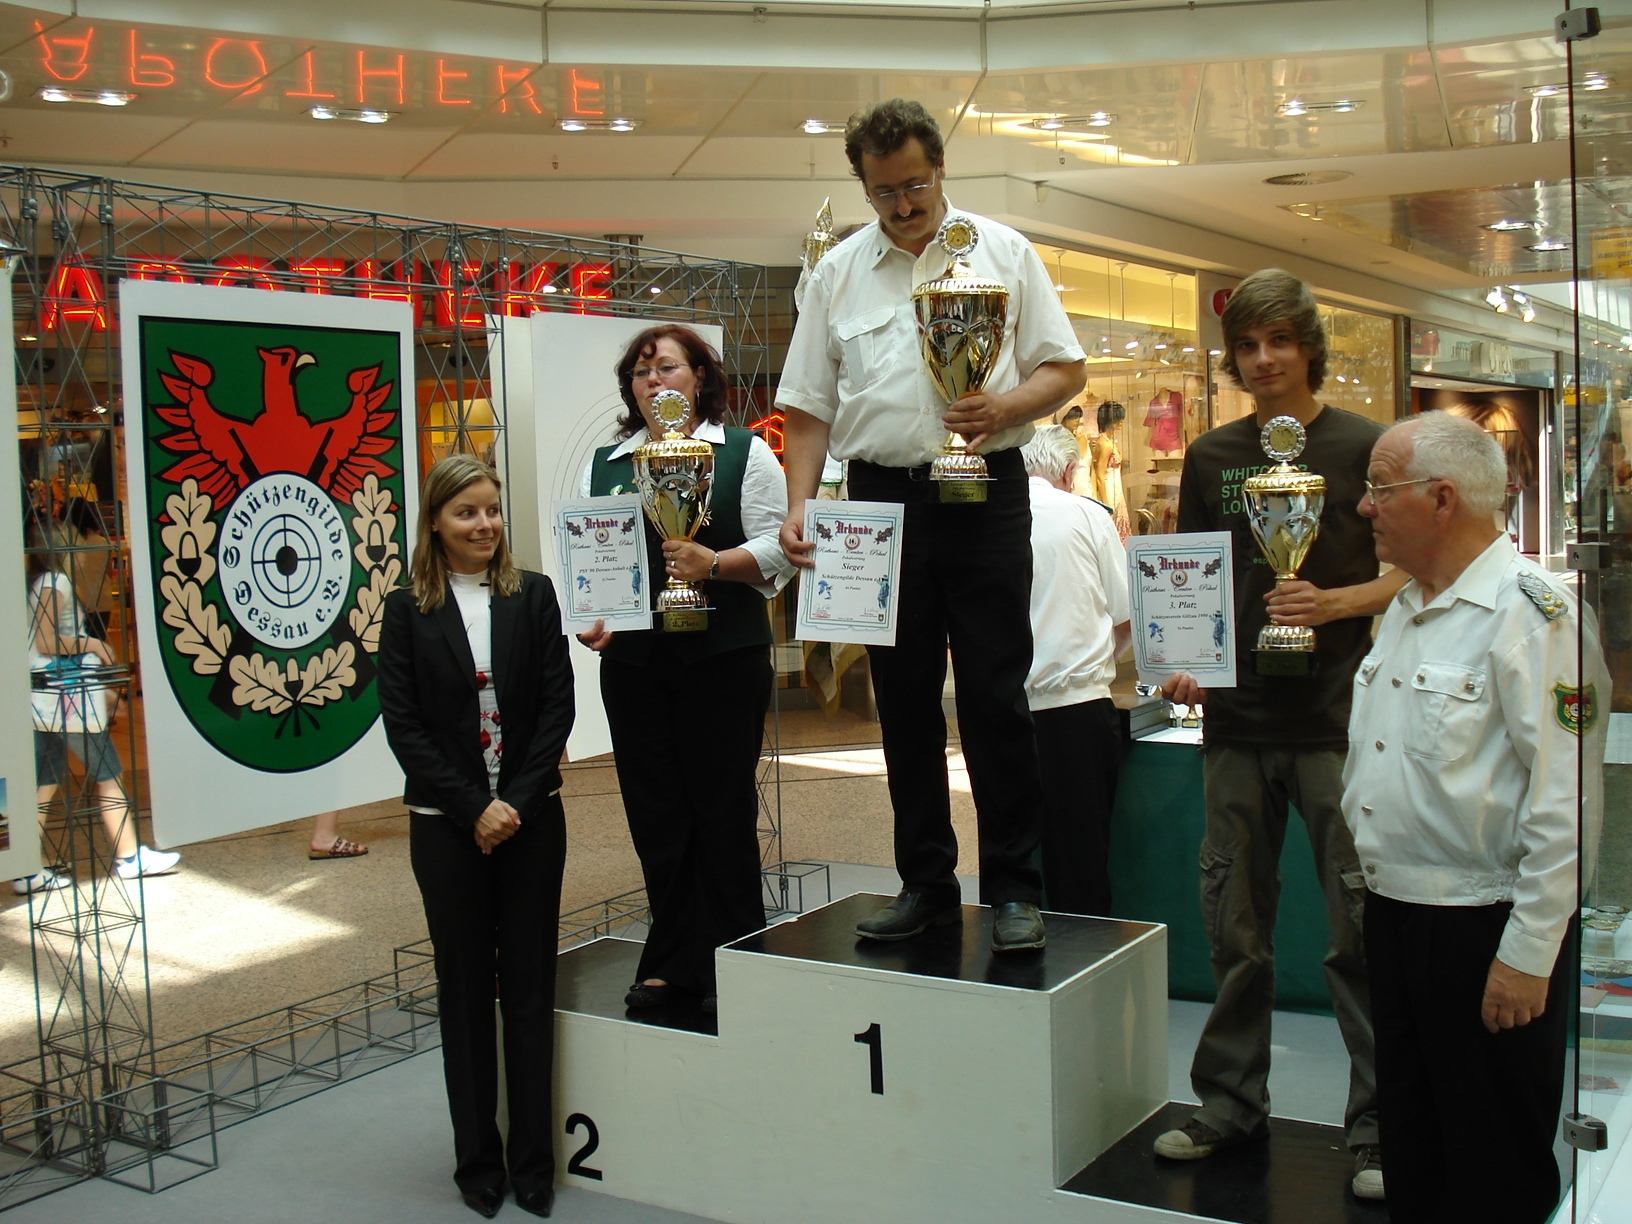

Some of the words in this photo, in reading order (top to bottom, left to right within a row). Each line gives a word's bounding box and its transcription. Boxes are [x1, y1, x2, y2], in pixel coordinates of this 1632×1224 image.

[835, 520, 873, 537] Urkunde
[842, 562, 865, 571] Sieger
[1158, 556, 1200, 574] Urkunde
[233, 580, 309, 640] Dessau
[1178, 601, 1197, 609] Platz
[854, 1022, 885, 1096] 1
[565, 1112, 603, 1182] 2
